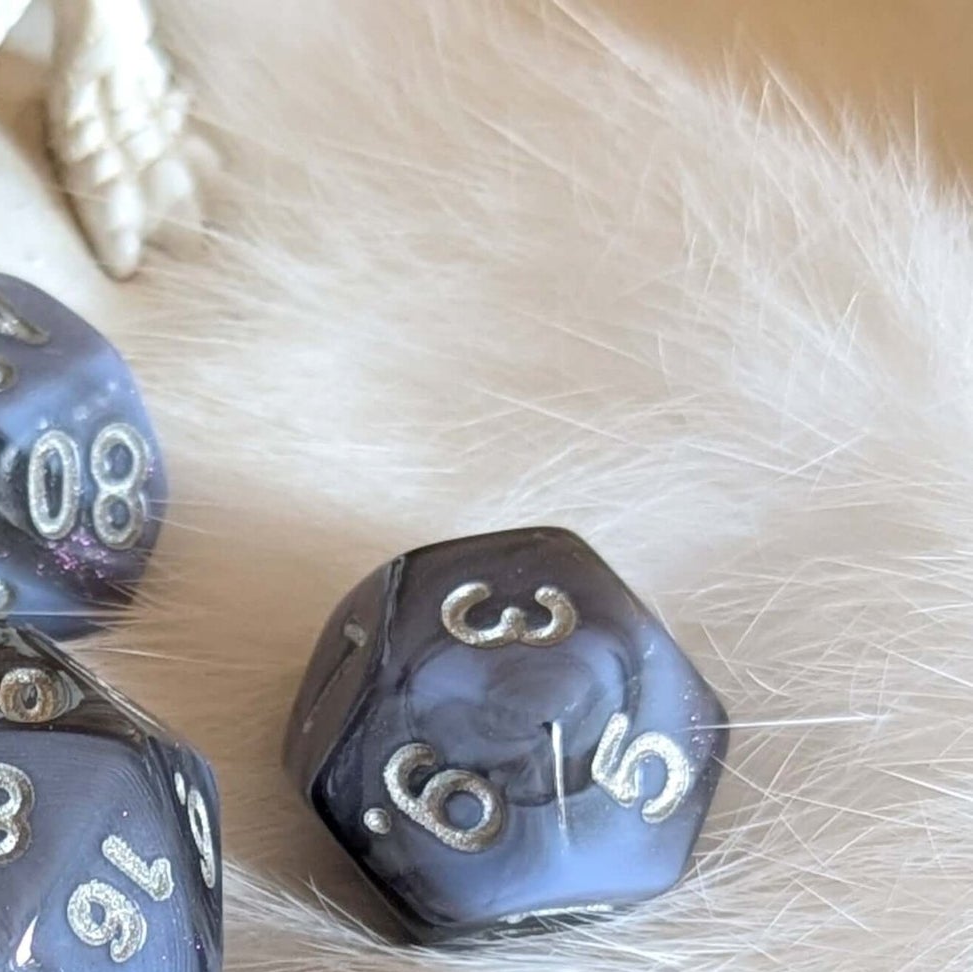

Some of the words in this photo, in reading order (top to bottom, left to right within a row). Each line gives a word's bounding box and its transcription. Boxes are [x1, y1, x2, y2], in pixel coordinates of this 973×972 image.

[29, 422, 148, 550] 80
[441, 581, 578, 648] 3
[591, 712, 689, 824] 5
[67, 834, 174, 963] 16
